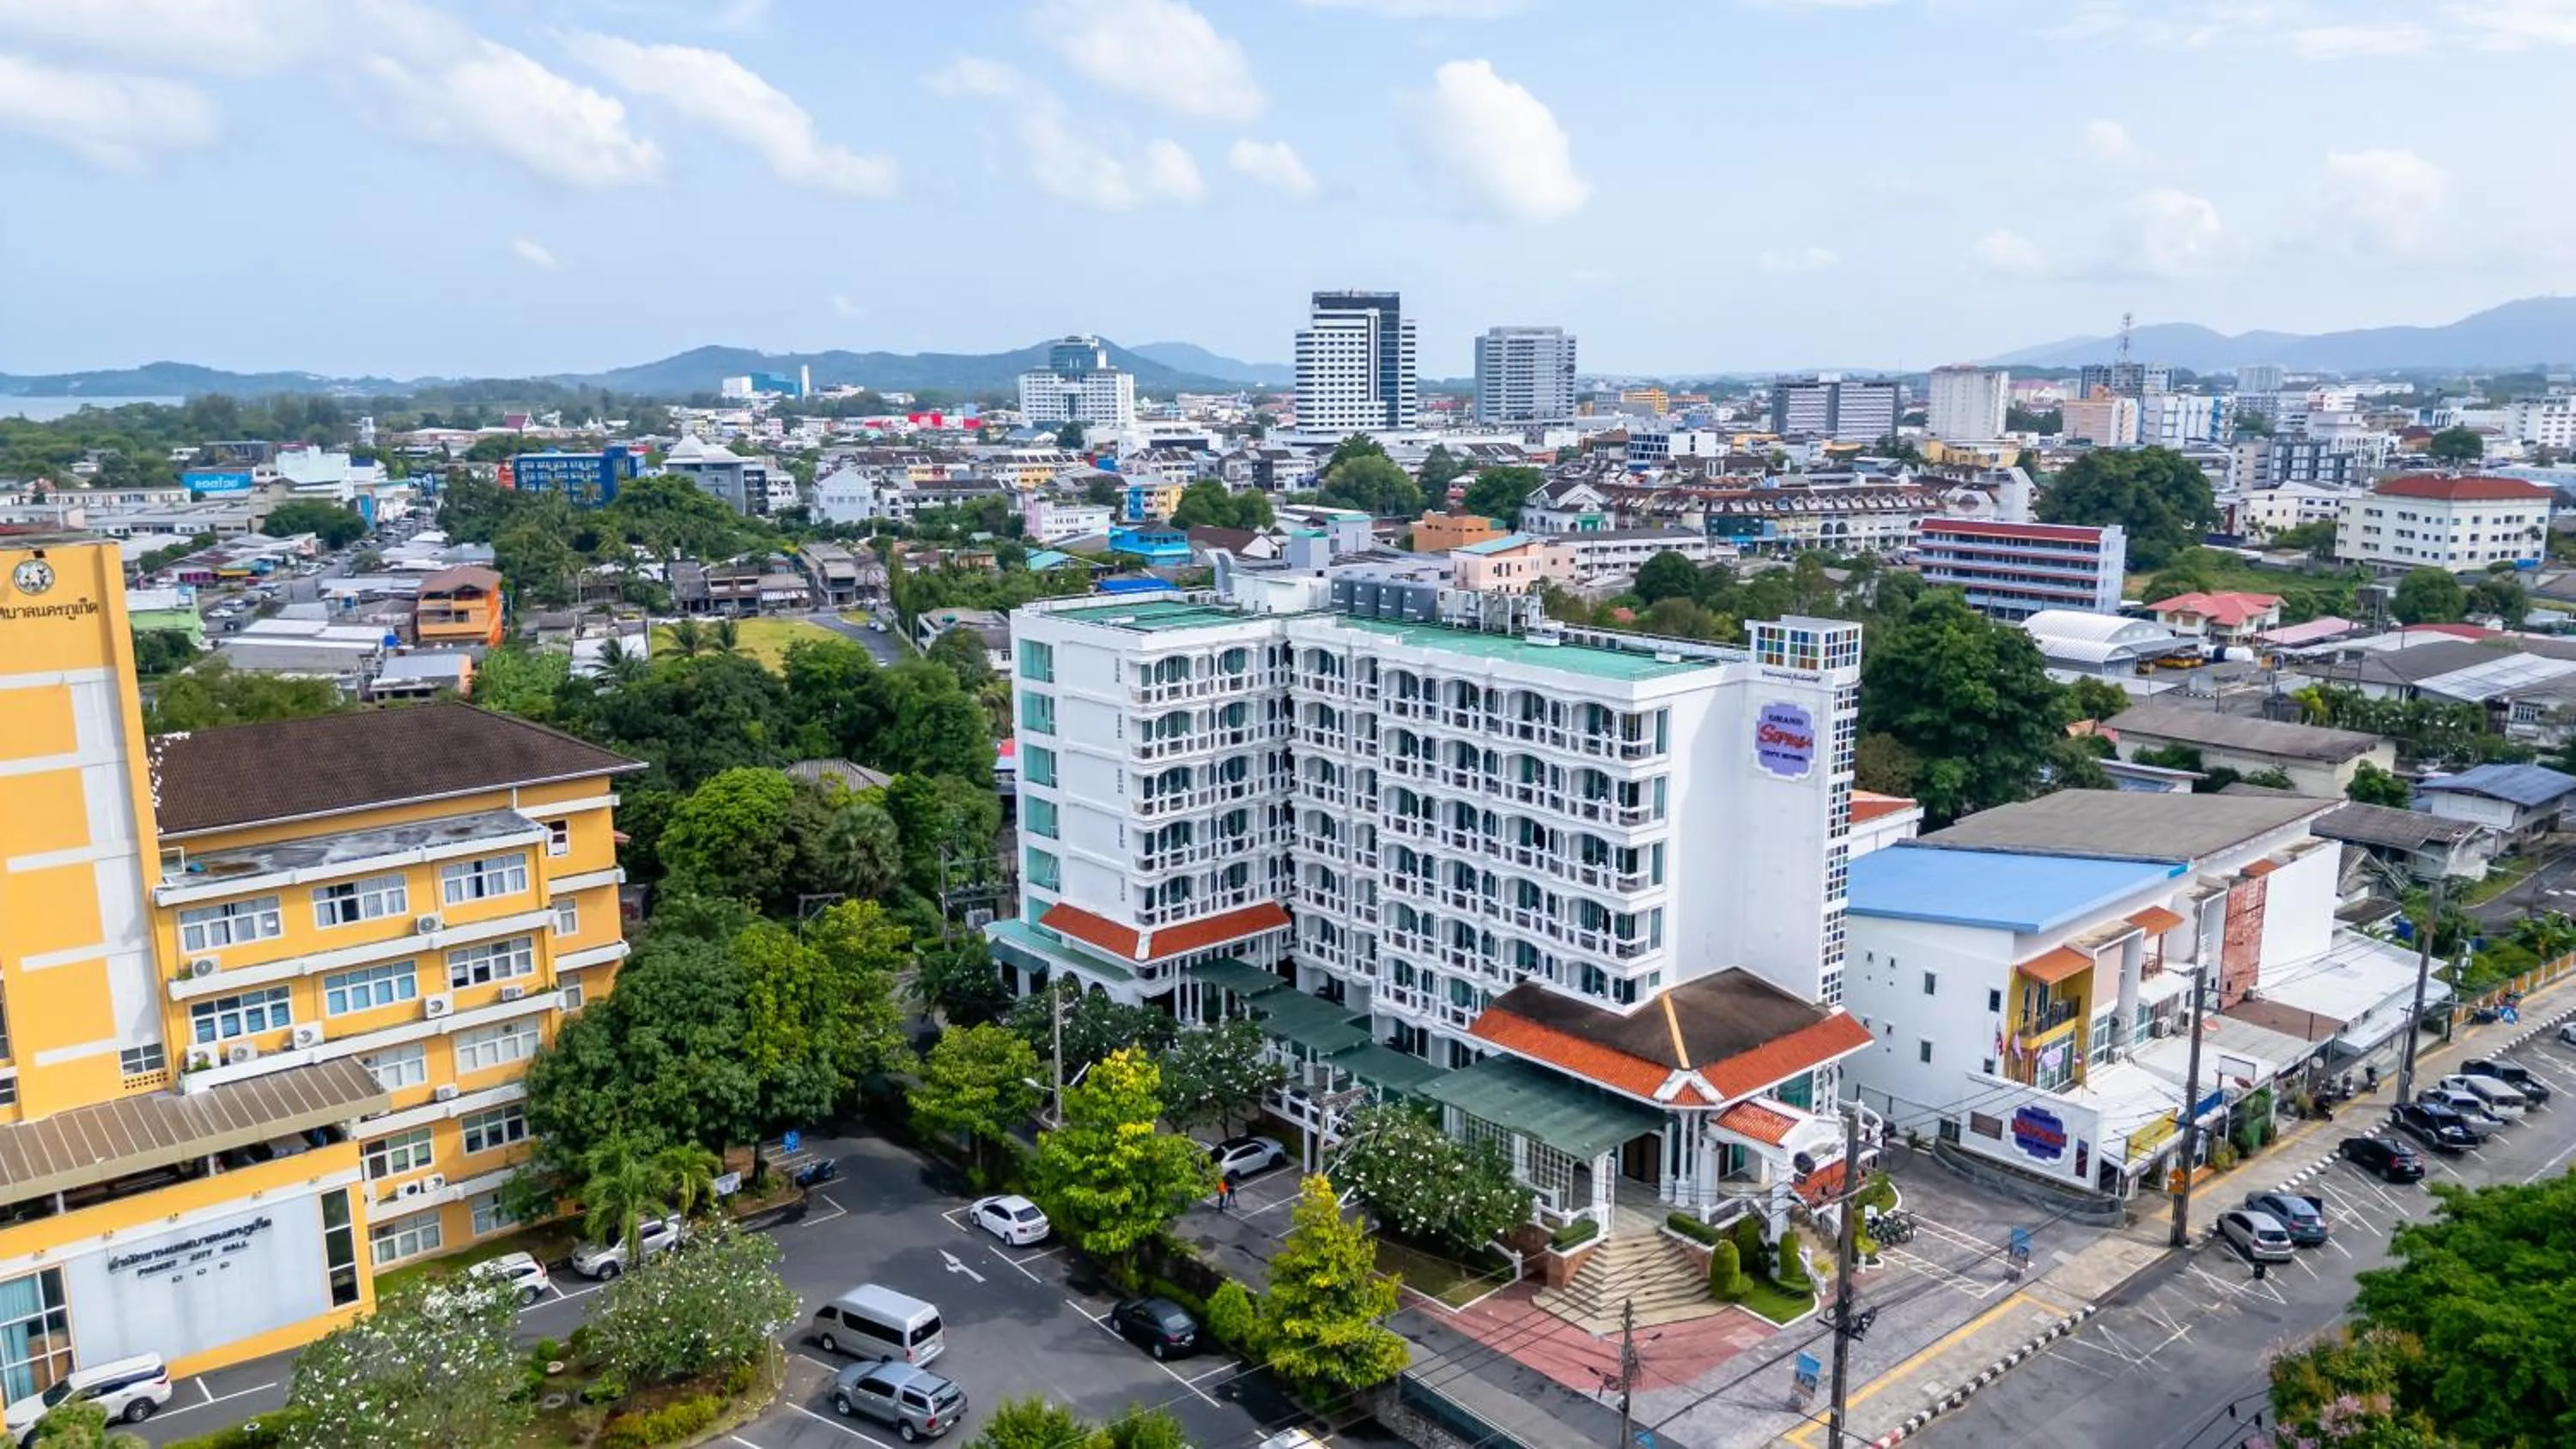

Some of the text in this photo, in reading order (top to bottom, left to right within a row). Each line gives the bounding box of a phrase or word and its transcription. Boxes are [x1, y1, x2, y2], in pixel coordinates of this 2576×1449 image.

[1768, 714, 1804, 725] GRAND
[190, 1248, 213, 1263] CITY
[222, 1240, 249, 1253] HALL
